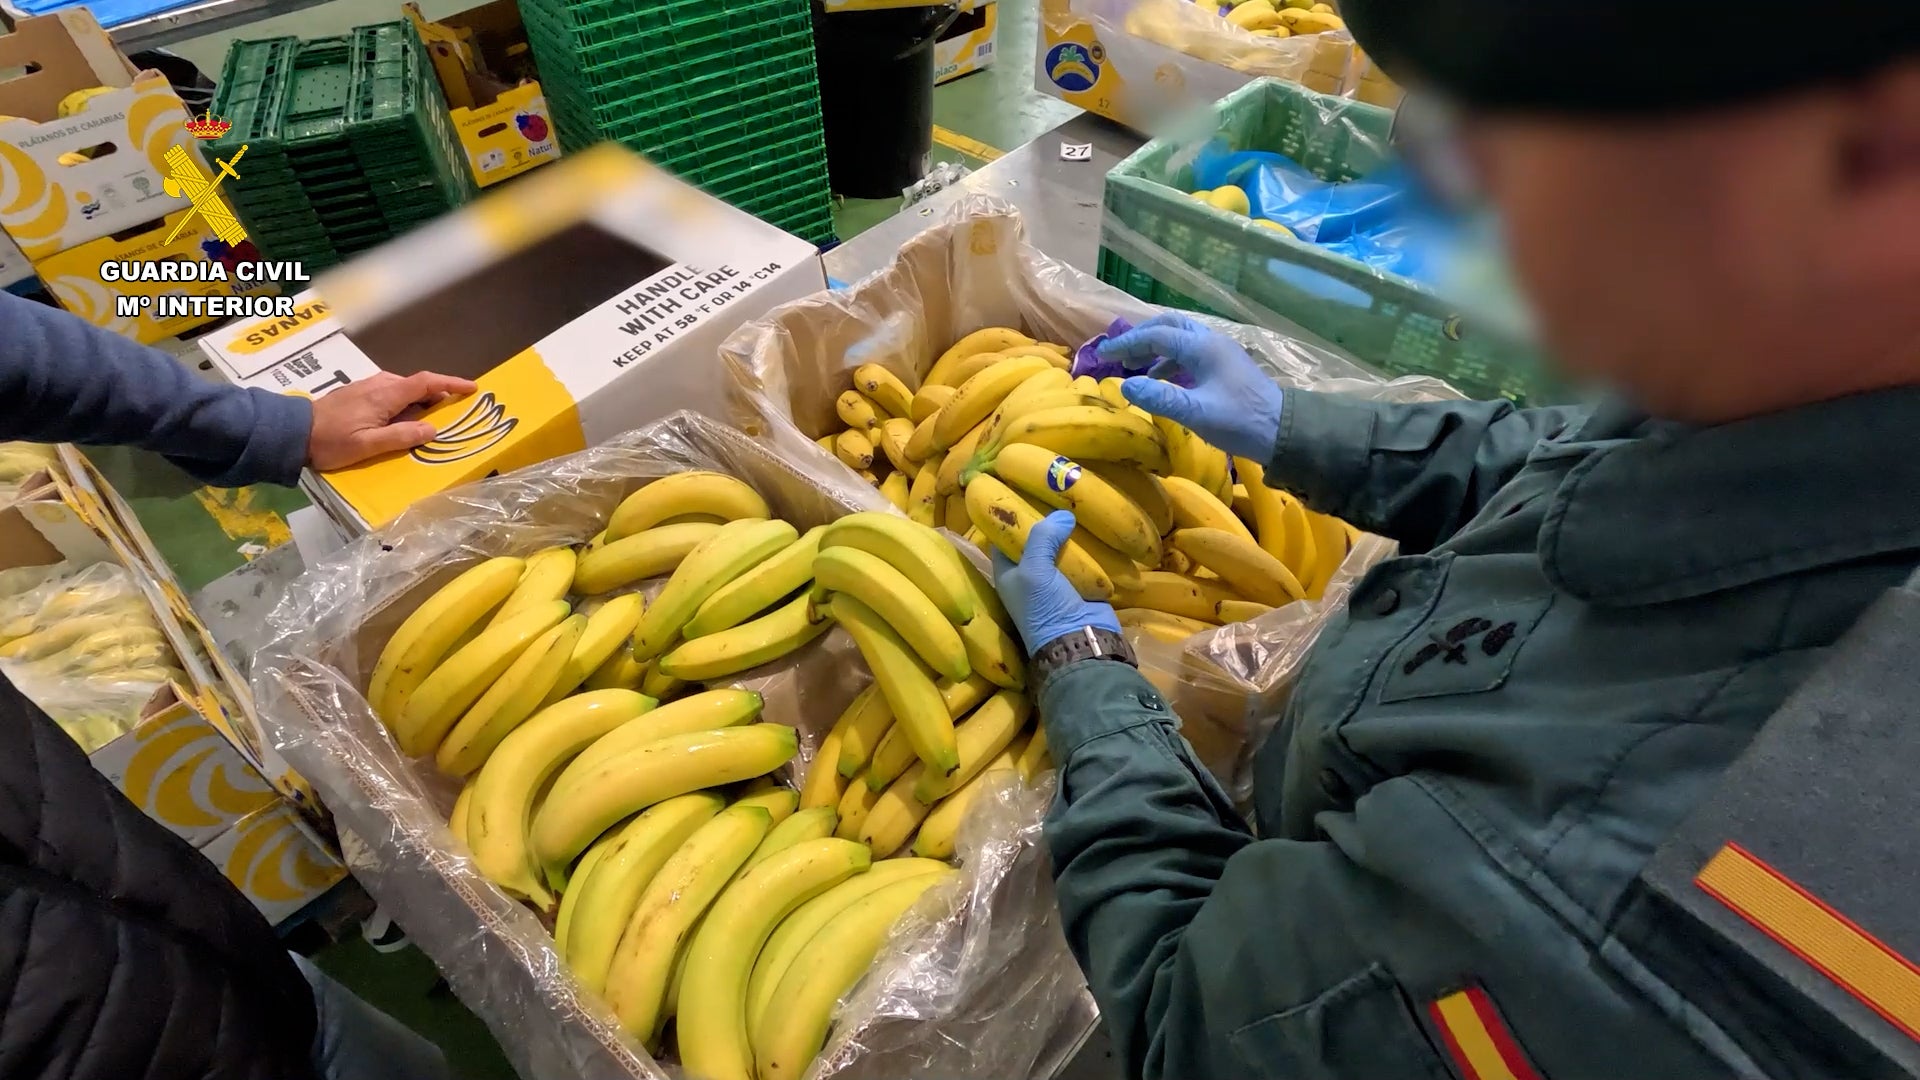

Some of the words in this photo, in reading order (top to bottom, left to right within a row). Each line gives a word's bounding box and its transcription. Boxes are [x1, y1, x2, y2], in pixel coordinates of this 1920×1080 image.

[528, 142, 553, 158] Natur
[1065, 146, 1089, 157] 27
[615, 263, 704, 315] HANDLE
[618, 297, 683, 337] WITH
[680, 264, 741, 301] CARE
[612, 340, 652, 368] KEEP
[654, 326, 676, 343] AT
[674, 313, 698, 329] 58
[711, 291, 735, 307] OR
[731, 280, 752, 293] 14
